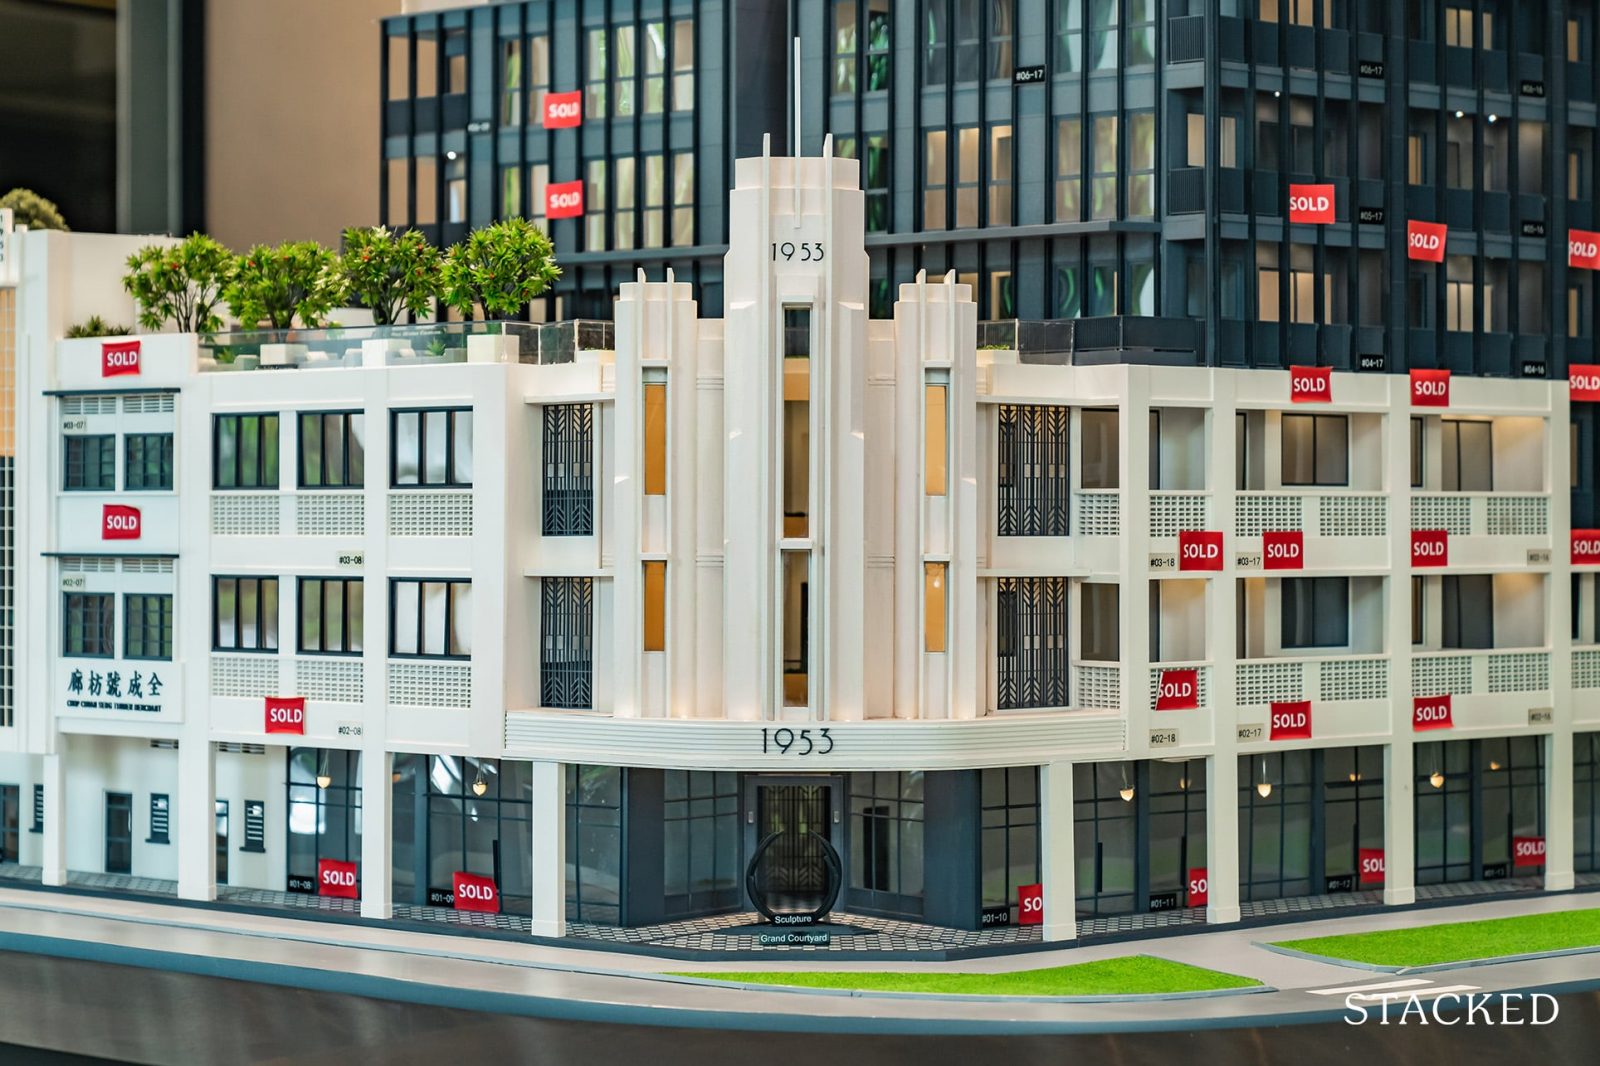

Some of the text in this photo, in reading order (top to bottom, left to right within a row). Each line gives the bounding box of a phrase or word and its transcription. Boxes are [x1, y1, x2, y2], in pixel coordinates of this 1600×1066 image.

[1016, 69, 1043, 80] #06-17
[548, 102, 579, 118] SOLD
[550, 191, 580, 209] SOLD
[1289, 197, 1329, 211] SOLD
[1410, 232, 1439, 250] SOLD
[772, 242, 824, 261] 1953
[1568, 241, 1597, 258] SOLD
[107, 351, 137, 367] SOLD
[1361, 358, 1384, 368] #04-17
[1293, 377, 1326, 392] SOLD
[1415, 381, 1446, 395] SOLD
[1570, 375, 1600, 390] SOLD
[106, 515, 137, 530] SOLD
[1183, 543, 1219, 558] SOLD
[1267, 543, 1299, 558] SOLD
[1413, 541, 1444, 556] SOLD
[1573, 540, 1600, 555] SOLD
[339, 555, 362, 565] #03-08
[1150, 558, 1175, 567] #03-18
[1237, 557, 1261, 566] #03-17
[1158, 682, 1191, 698] SOLD
[270, 708, 303, 723] SOLD
[1273, 713, 1306, 728] SOLD
[1416, 705, 1447, 721] SOLD
[338, 726, 362, 736] #02-08
[1151, 734, 1176, 743] #02-18
[1238, 728, 1261, 738] #02-17
[761, 728, 833, 755] 1953
[1516, 841, 1545, 856] SOLD
[1363, 858, 1384, 872] SOL
[323, 870, 354, 886] SOLD
[459, 883, 493, 900] SOLD
[1190, 879, 1207, 894] SO
[431, 893, 454, 903] #01-09
[1024, 896, 1042, 912] SO
[1150, 898, 1174, 908] #01-11
[774, 915, 812, 924] Sculpture
[982, 912, 1007, 923] #01-10
[760, 934, 828, 943] Grand Courtyard
